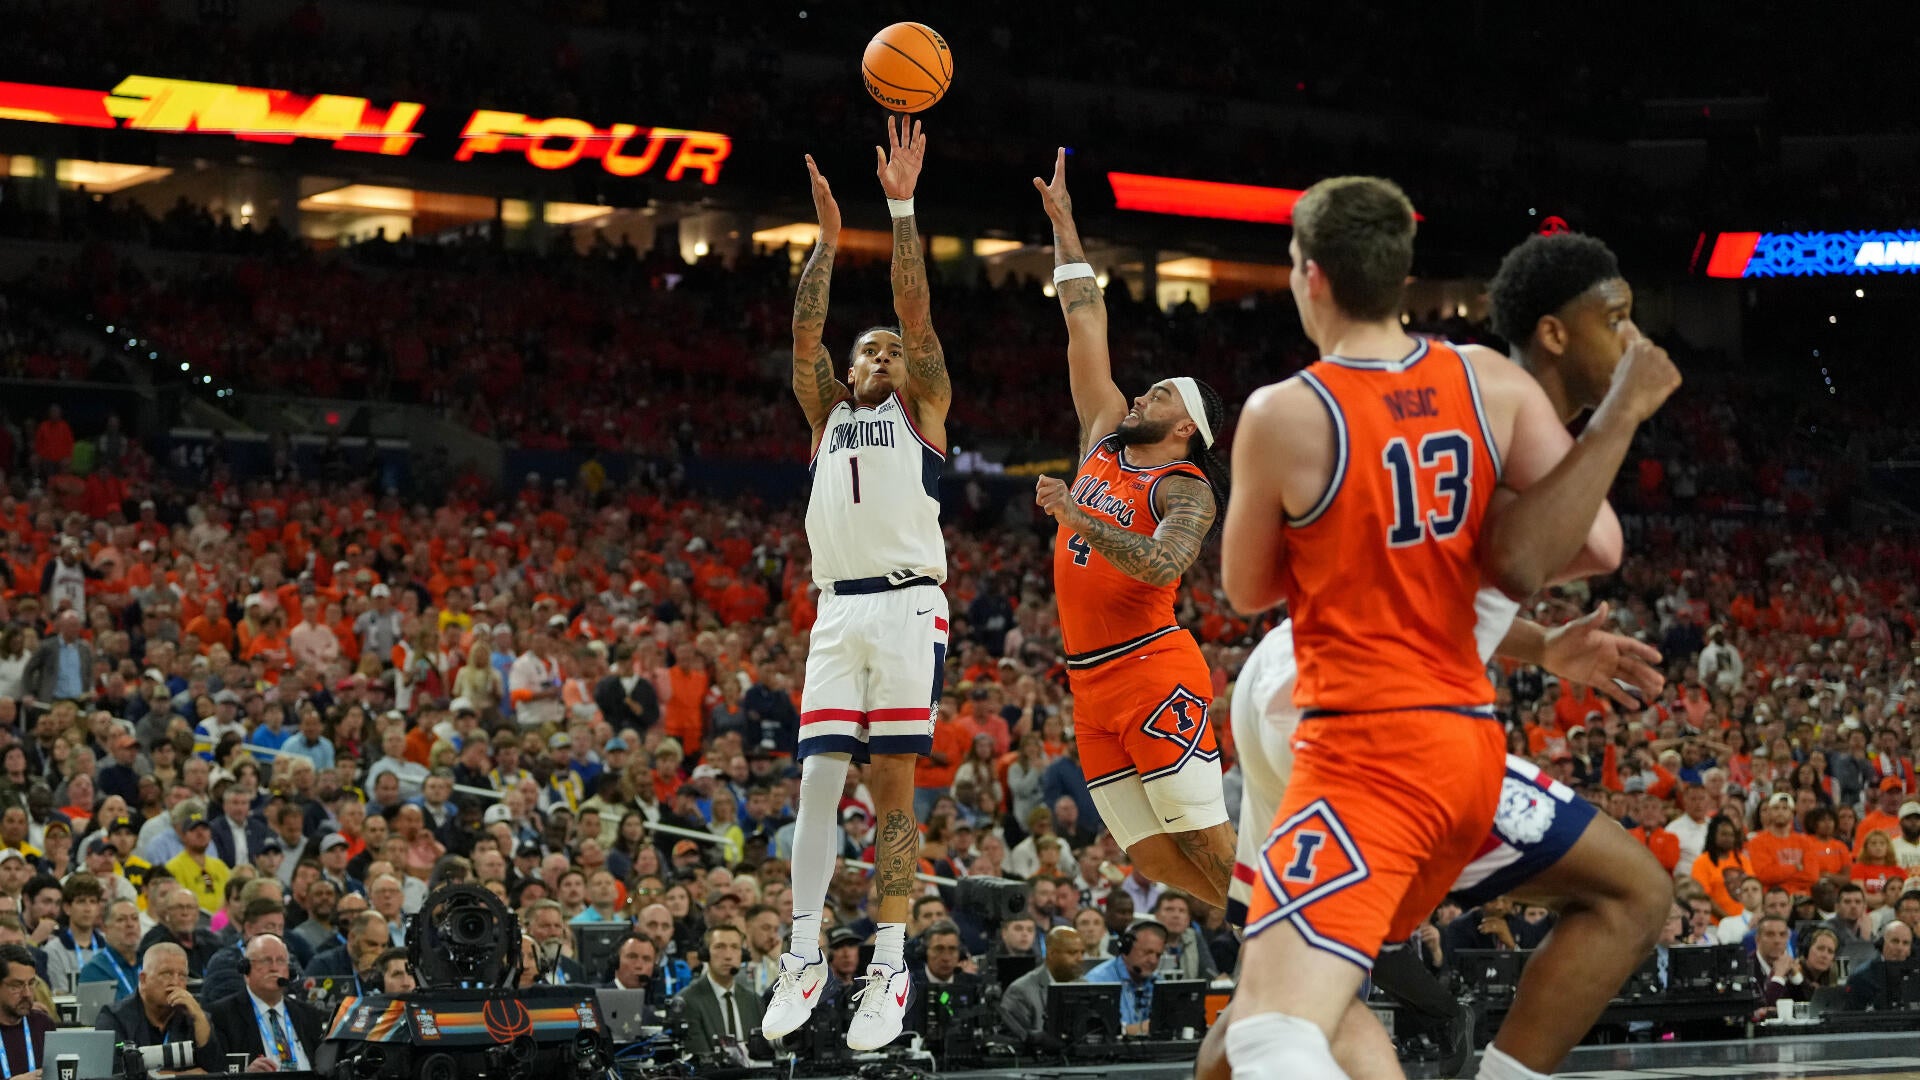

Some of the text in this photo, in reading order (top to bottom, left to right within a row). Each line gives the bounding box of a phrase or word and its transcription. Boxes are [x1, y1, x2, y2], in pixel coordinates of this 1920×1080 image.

[453, 109, 732, 185] FOUR
[849, 457, 861, 504] 1
[1070, 474, 1136, 528] Illinois
[1382, 428, 1473, 548] 13
[1067, 532, 1092, 567] 4
[1171, 701, 1195, 733] I
[1282, 829, 1327, 884] I
